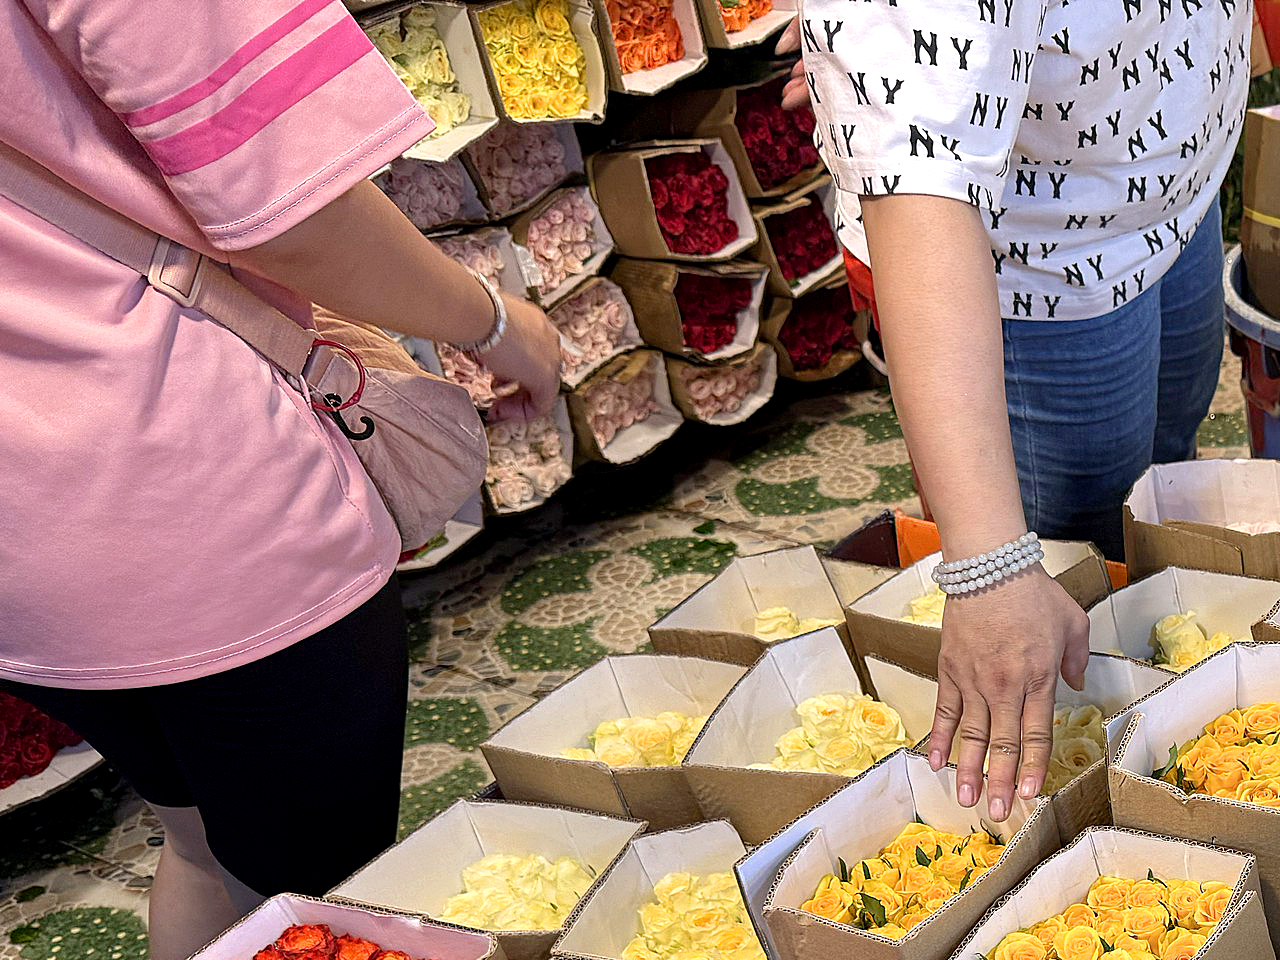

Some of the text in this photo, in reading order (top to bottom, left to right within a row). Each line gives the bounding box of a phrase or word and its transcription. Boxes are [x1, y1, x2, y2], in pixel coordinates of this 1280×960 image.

[802, 19, 844, 53] NY
[913, 29, 974, 71] NY
[1011, 48, 1035, 84] NY
[1079, 41, 1123, 87] NY
[846, 72, 905, 106] NY
[969, 92, 1009, 130] NY
[1022, 100, 1076, 122] NY
[1077, 109, 1122, 148] NY
[829, 123, 857, 158] NY
[909, 124, 963, 161] NY
[1127, 109, 1168, 161] NY
[1015, 169, 1068, 200] NY
[1127, 174, 1177, 204] NY
[1064, 214, 1117, 230] NY
[1143, 217, 1181, 256] NY
[1009, 241, 1059, 265] NY
[1063, 254, 1104, 287] NY
[1012, 291, 1062, 318] NY
[1112, 268, 1146, 308] NY
